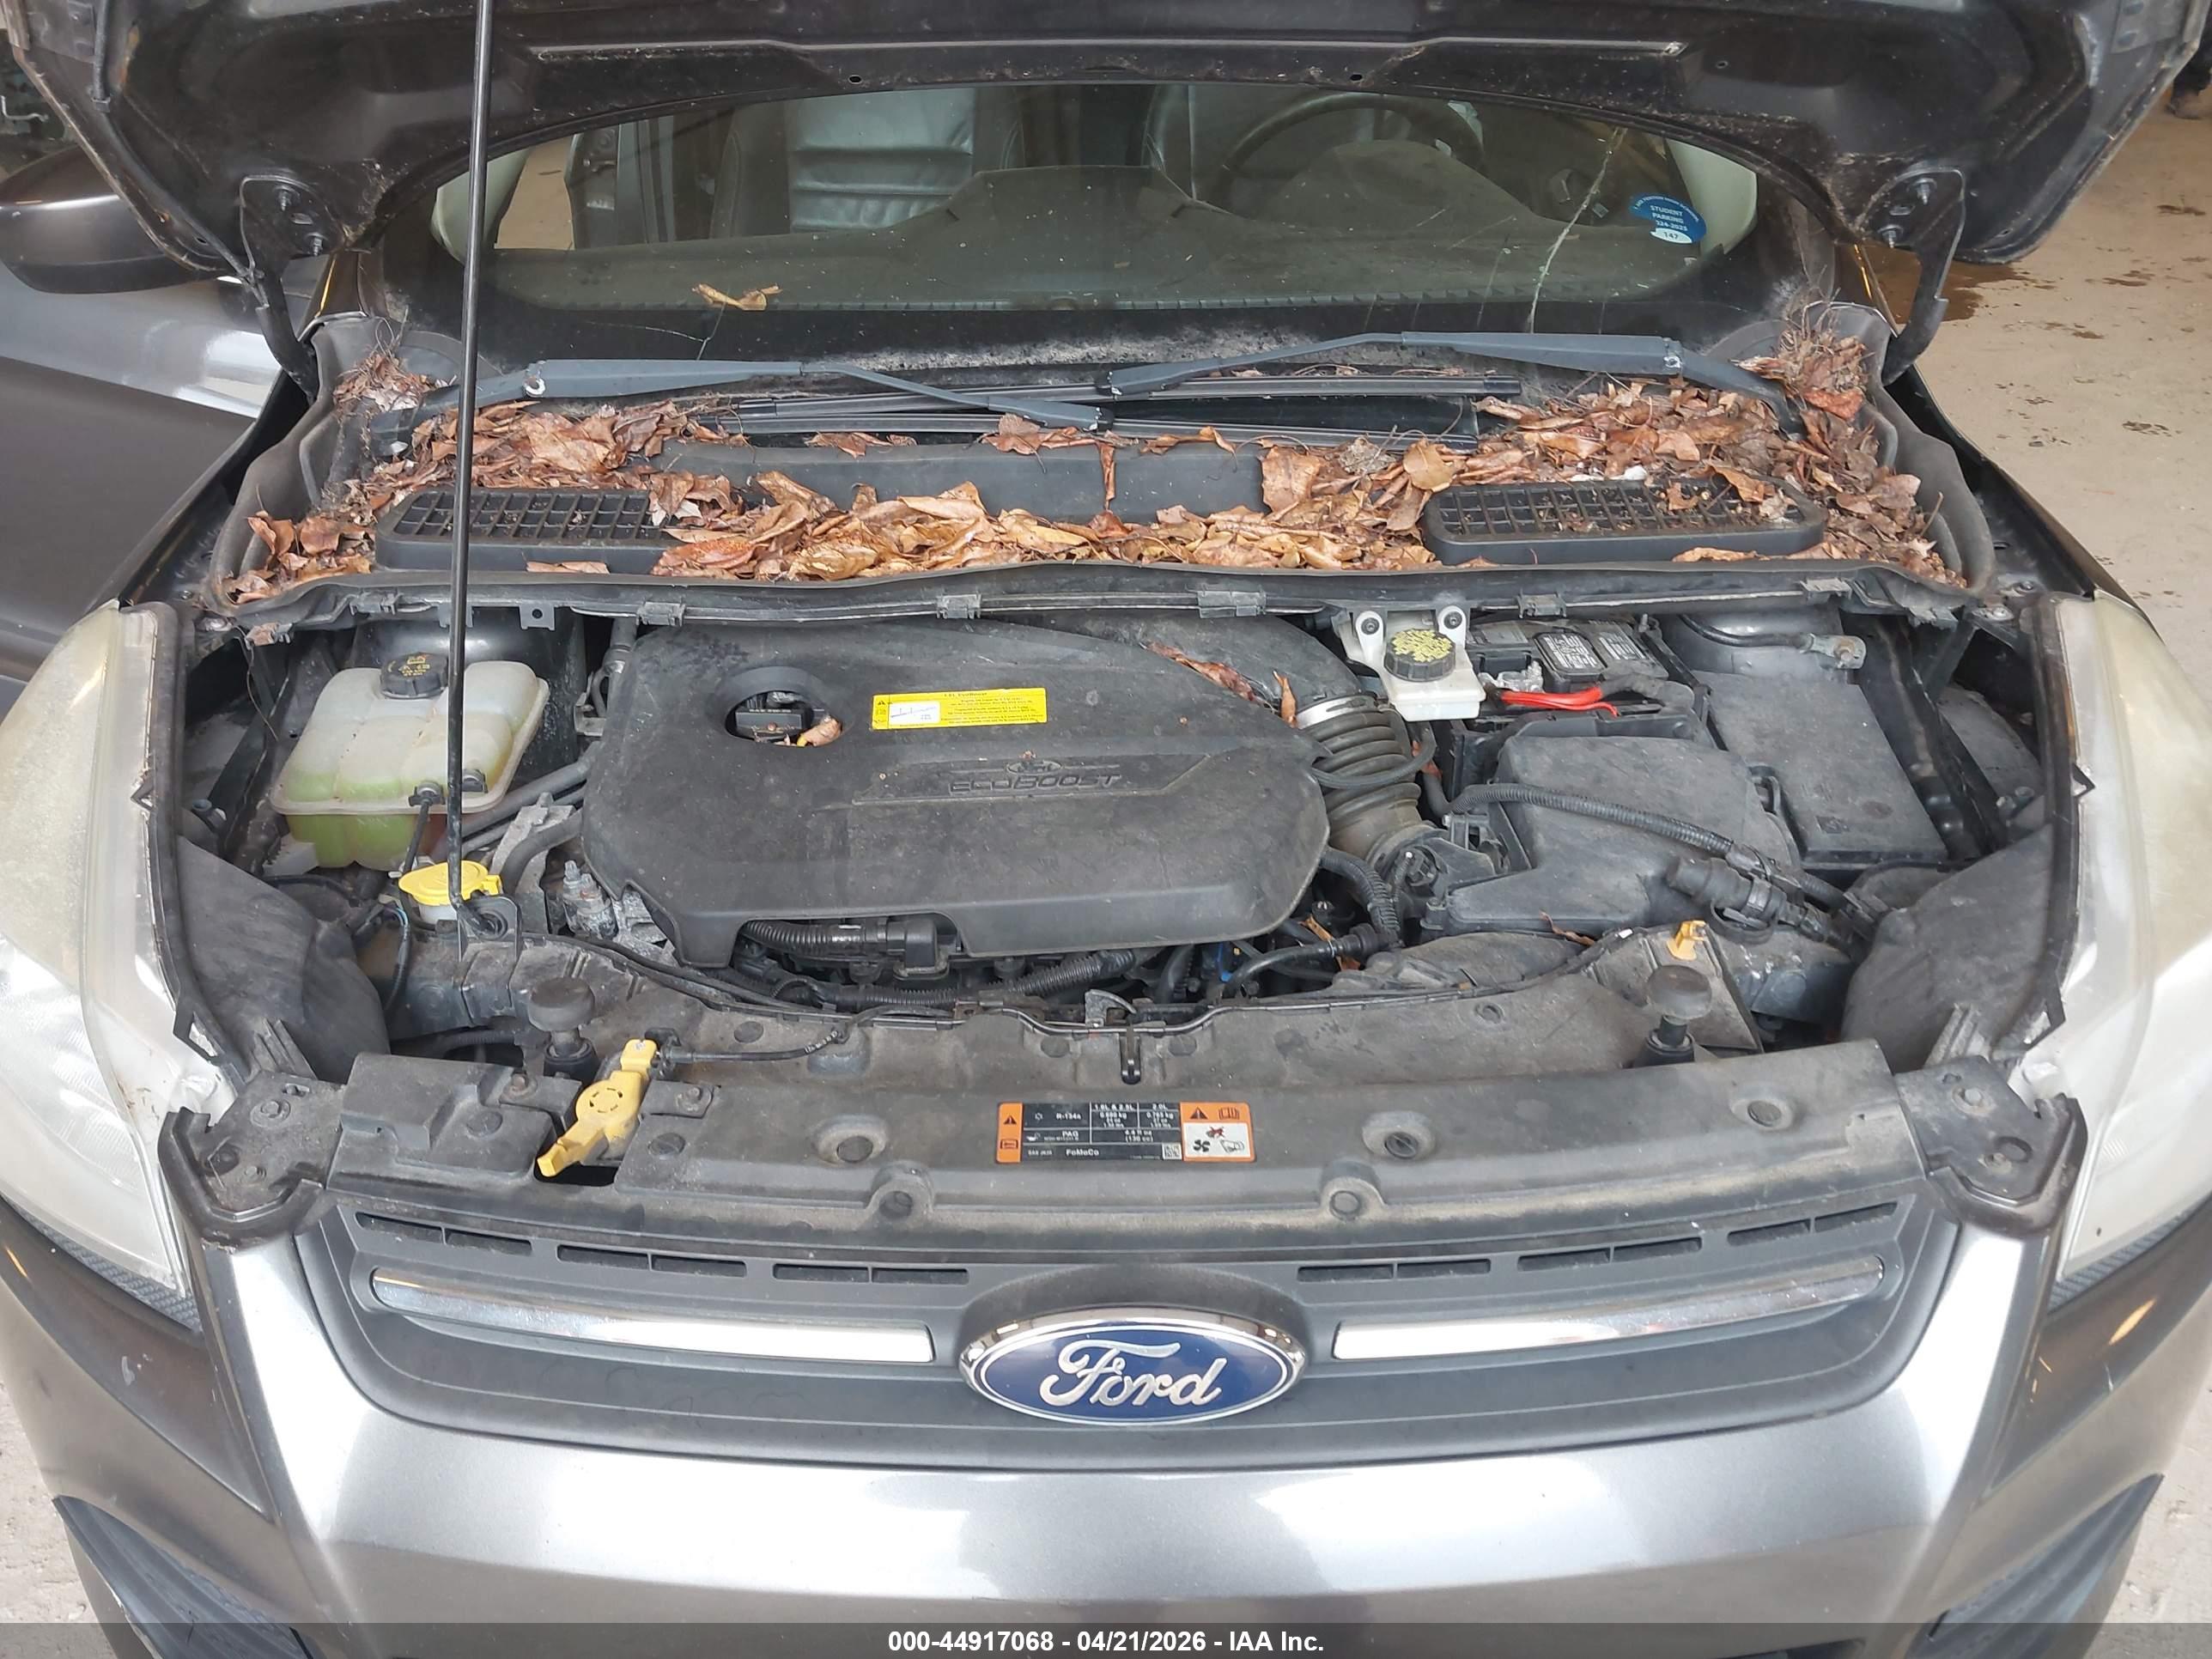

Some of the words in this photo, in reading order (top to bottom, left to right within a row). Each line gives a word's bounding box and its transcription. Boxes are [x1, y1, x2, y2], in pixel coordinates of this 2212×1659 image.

[1650, 205, 1683, 216] STUDENT
[1652, 213, 1684, 224] PARKING
[950, 775, 1121, 795] ECOBOOST
[1039, 1338, 1227, 1407] Ford
